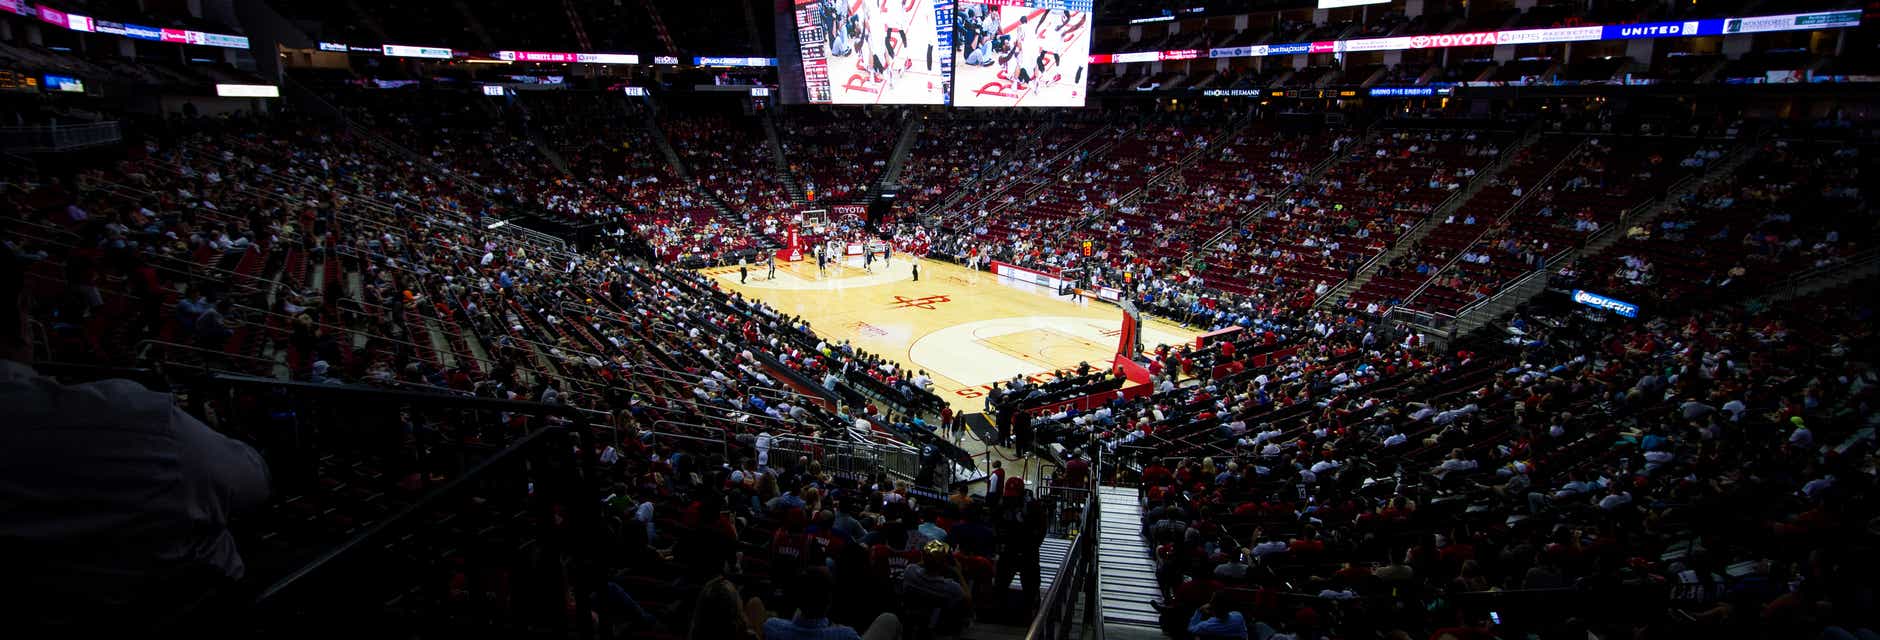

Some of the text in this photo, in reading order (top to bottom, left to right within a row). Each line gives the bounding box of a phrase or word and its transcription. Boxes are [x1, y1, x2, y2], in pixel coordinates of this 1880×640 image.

[1621, 26, 1679, 36] UNITED
[1429, 32, 1496, 46] TOYOTA
[1203, 89, 1259, 97] MEMORIAL HERMANN
[833, 206, 866, 214] TOYOTA
[1581, 293, 1634, 313] BUD LIGHT
